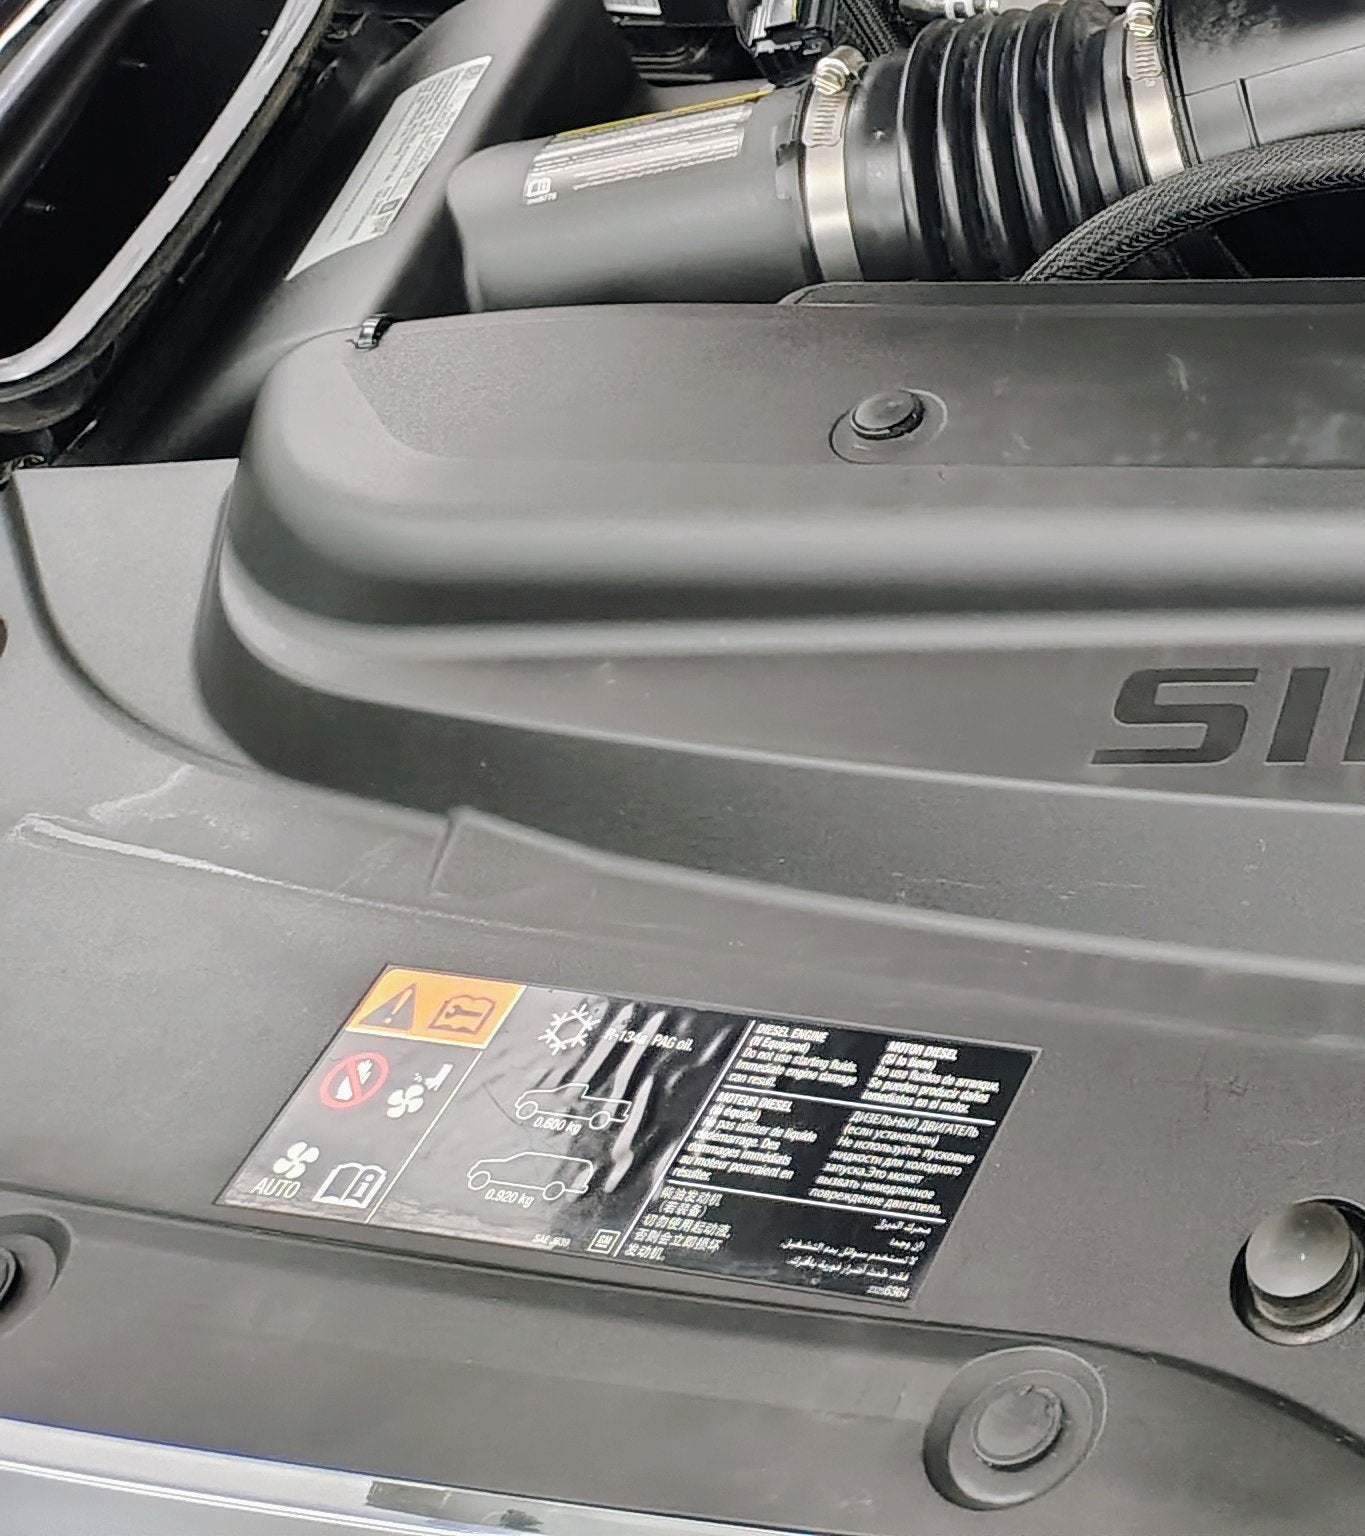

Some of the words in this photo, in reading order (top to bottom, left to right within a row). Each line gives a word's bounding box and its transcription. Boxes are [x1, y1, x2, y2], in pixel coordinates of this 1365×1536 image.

[651, 1033, 677, 1048] PAG
[755, 1023, 789, 1037] DIESEL
[790, 1028, 828, 1042] ENGINE
[741, 1047, 757, 1058] Do
[756, 1051, 775, 1061] not
[773, 1053, 792, 1063] use
[791, 1055, 830, 1070] starting
[887, 1041, 924, 1055] MOTOR
[923, 1045, 957, 1060] DIESEL
[728, 1073, 747, 1082] can
[735, 1059, 785, 1075] Immediate
[785, 1067, 818, 1080] engine
[817, 1071, 857, 1087] damage
[889, 1069, 908, 1079] use
[908, 1069, 941, 1084] fluidos
[881, 1081, 919, 1093] pueden
[917, 1085, 960, 1100] producir
[716, 1091, 759, 1106] MOTEUR
[757, 1097, 792, 1112] DIESEL
[533, 1116, 566, 1130] 0.600
[564, 1121, 582, 1135] kg
[714, 1119, 736, 1131] pas
[735, 1122, 770, 1135] utiliser
[783, 1127, 817, 1142] liquide
[849, 1111, 919, 1129] ДИЗЕЛЬНЫЙ
[917, 1120, 979, 1137] ДВИГАТЕЛЬ
[759, 1137, 780, 1150] Des
[693, 1156, 730, 1169] moteur
[727, 1162, 780, 1177] pourraient
[881, 1157, 904, 1168] для
[250, 1177, 300, 1198] AUTO
[484, 1188, 518, 1203] 0.920
[517, 1192, 534, 1208] kg
